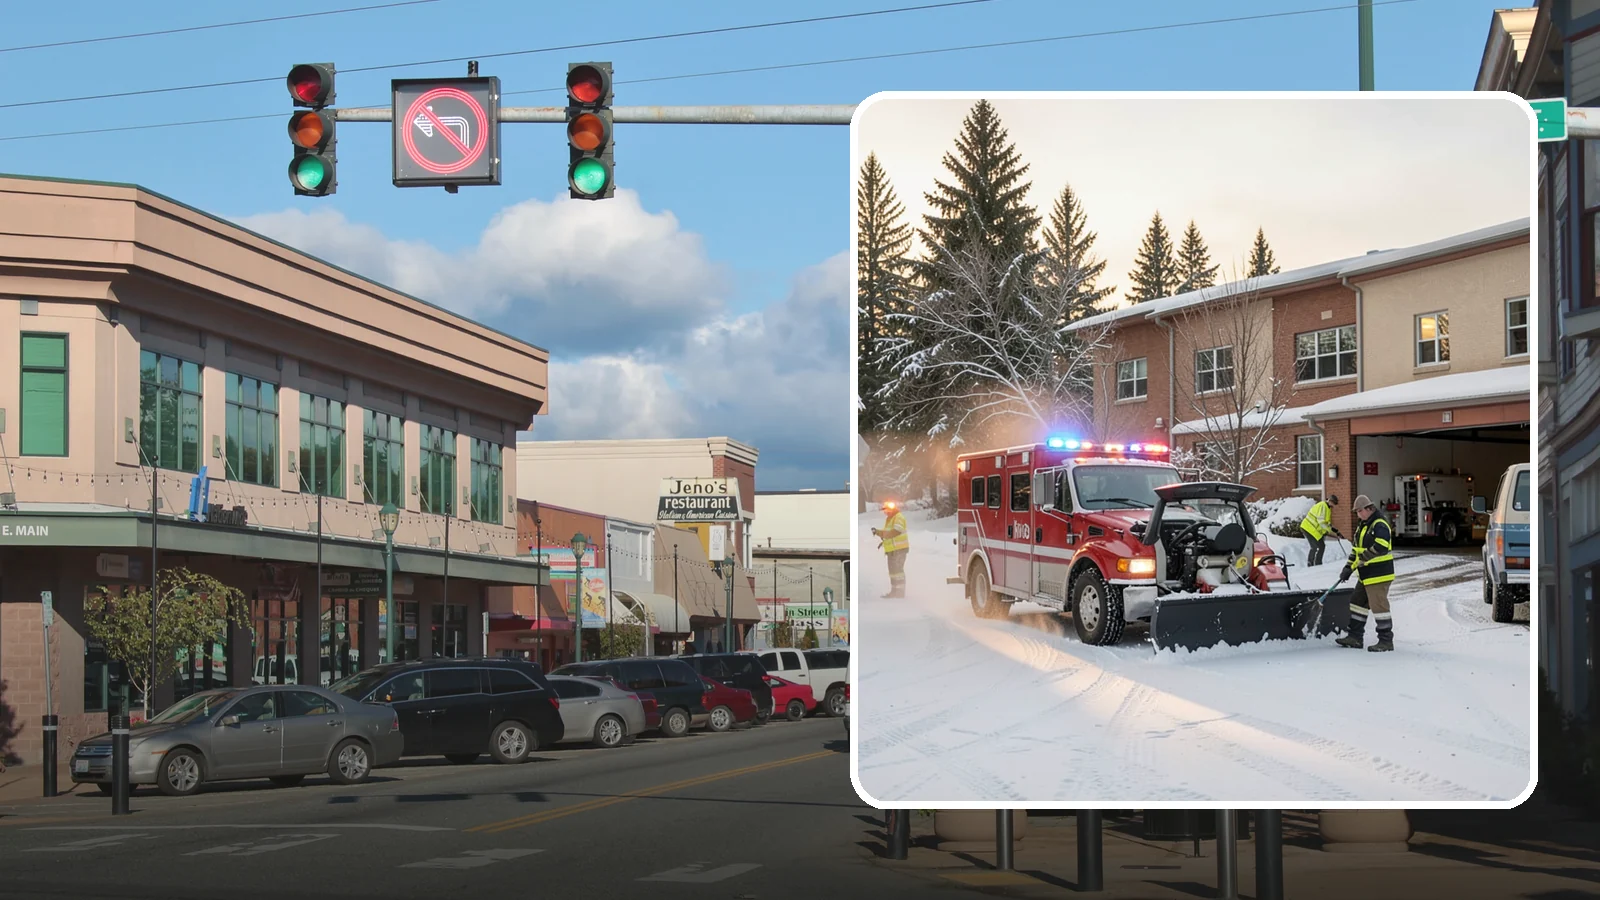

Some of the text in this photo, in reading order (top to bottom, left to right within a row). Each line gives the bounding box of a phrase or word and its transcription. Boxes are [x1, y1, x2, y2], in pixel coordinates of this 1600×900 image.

[670, 480, 727, 494] Jeno's
[665, 497, 731, 509] restaurant
[658, 510, 681, 519] Italian
[686, 509, 714, 519] American
[715, 509, 738, 519] Cuisine
[2, 525, 49, 536] E. MAIN
[797, 607, 829, 617] Street
